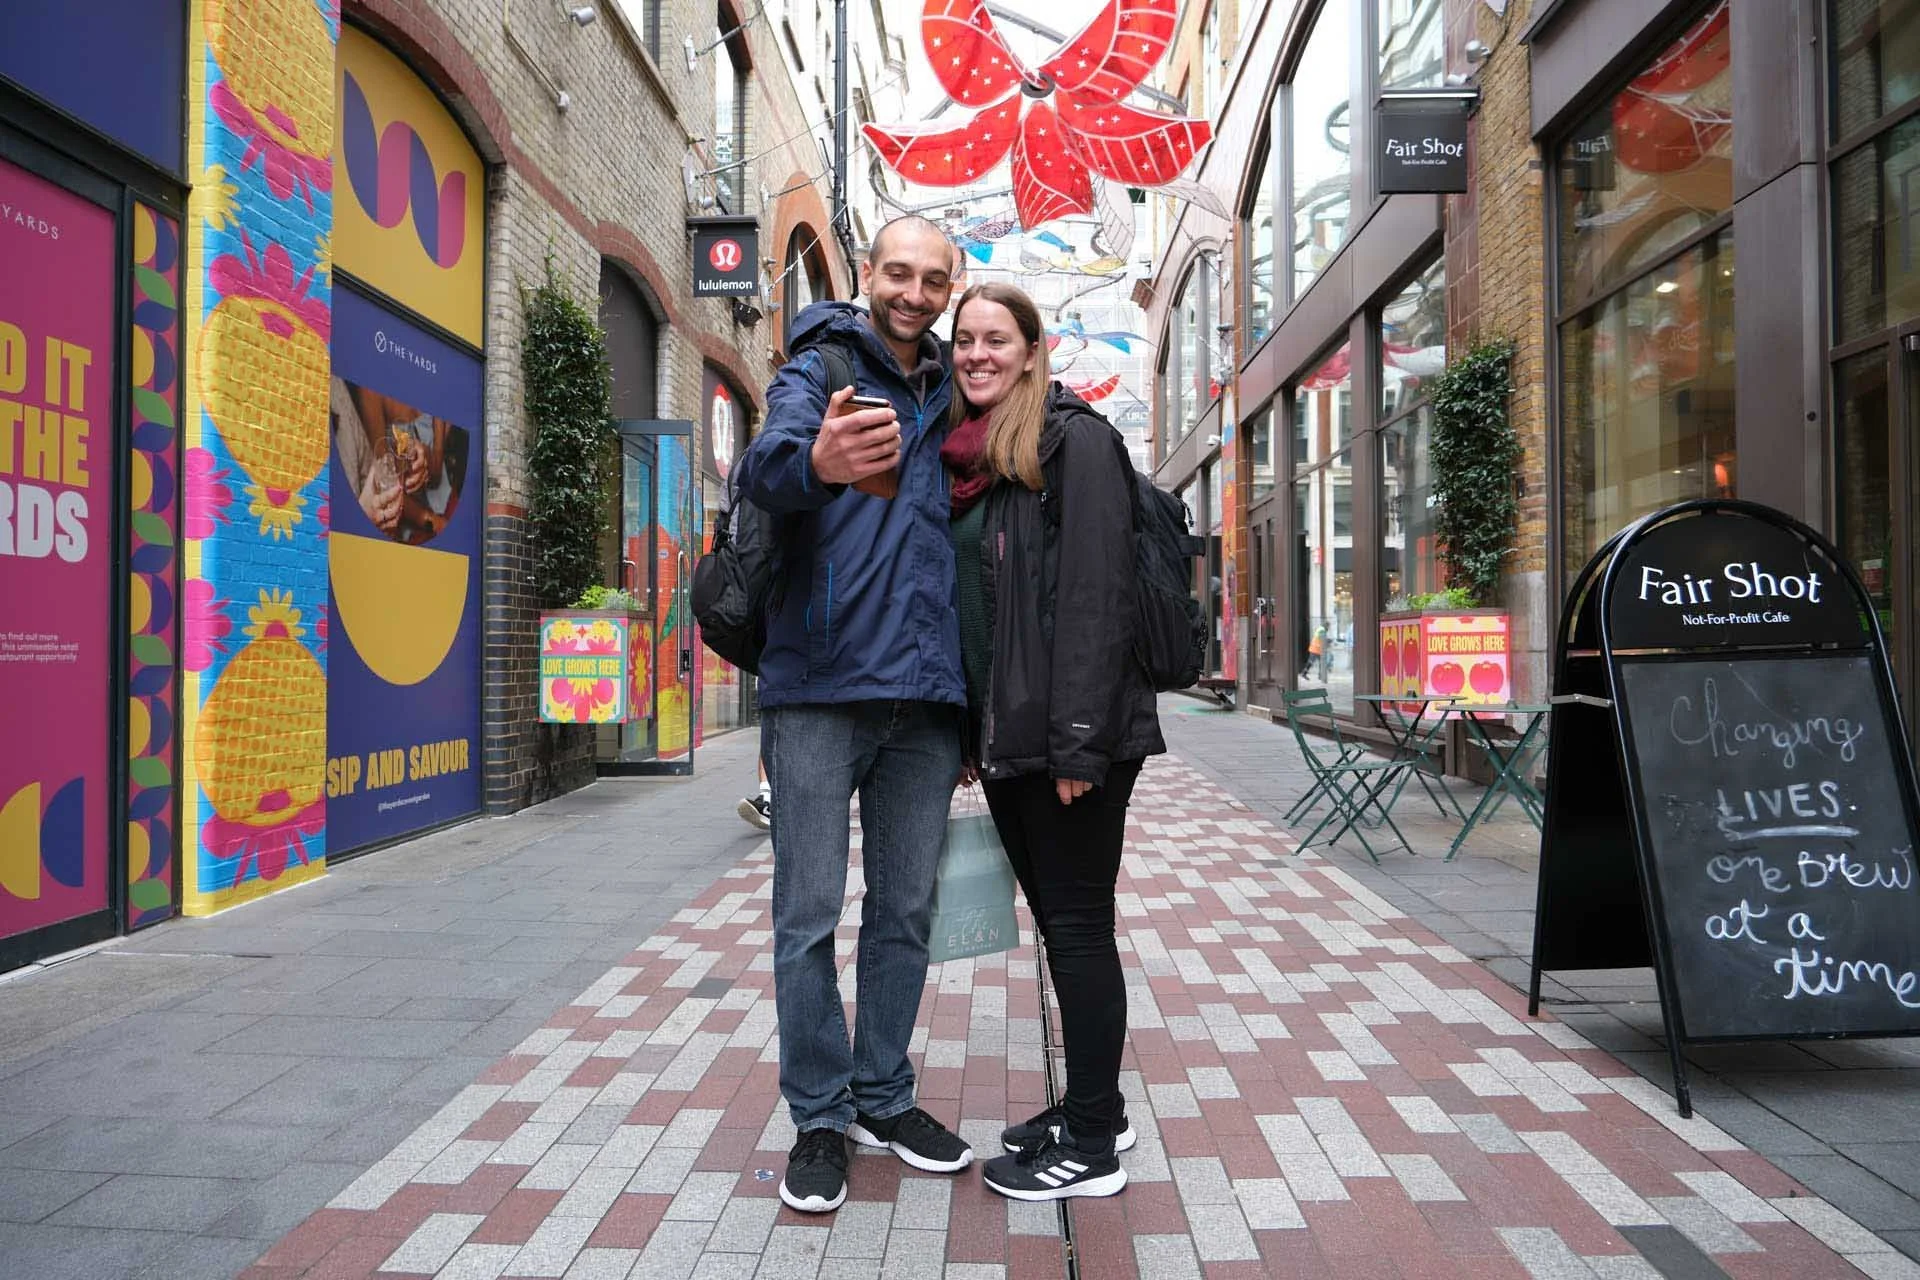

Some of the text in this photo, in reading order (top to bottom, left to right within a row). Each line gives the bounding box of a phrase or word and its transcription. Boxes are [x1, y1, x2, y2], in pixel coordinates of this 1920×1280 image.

[1385, 138, 1464, 157] Fair Shot
[2, 203, 59, 240] YARDS
[698, 279, 753, 291] lululemon
[45, 336, 92, 412] IT
[389, 340, 437, 375] THE YARDS
[0, 399, 90, 488] THE
[1639, 562, 1822, 605] Fair Shot
[1682, 611, 1791, 626] Not-For-Profit Cafe
[1428, 635, 1505, 652] LOVE GROWS HERE
[544, 658, 563, 675] LOVE
[565, 658, 597, 675] GROWS
[1670, 677, 1864, 769] Changing
[327, 738, 469, 798] SIP AND SAVOUR
[1707, 855, 1792, 893] one
[1705, 899, 1826, 944] at a
[1774, 947, 1920, 1008] time
